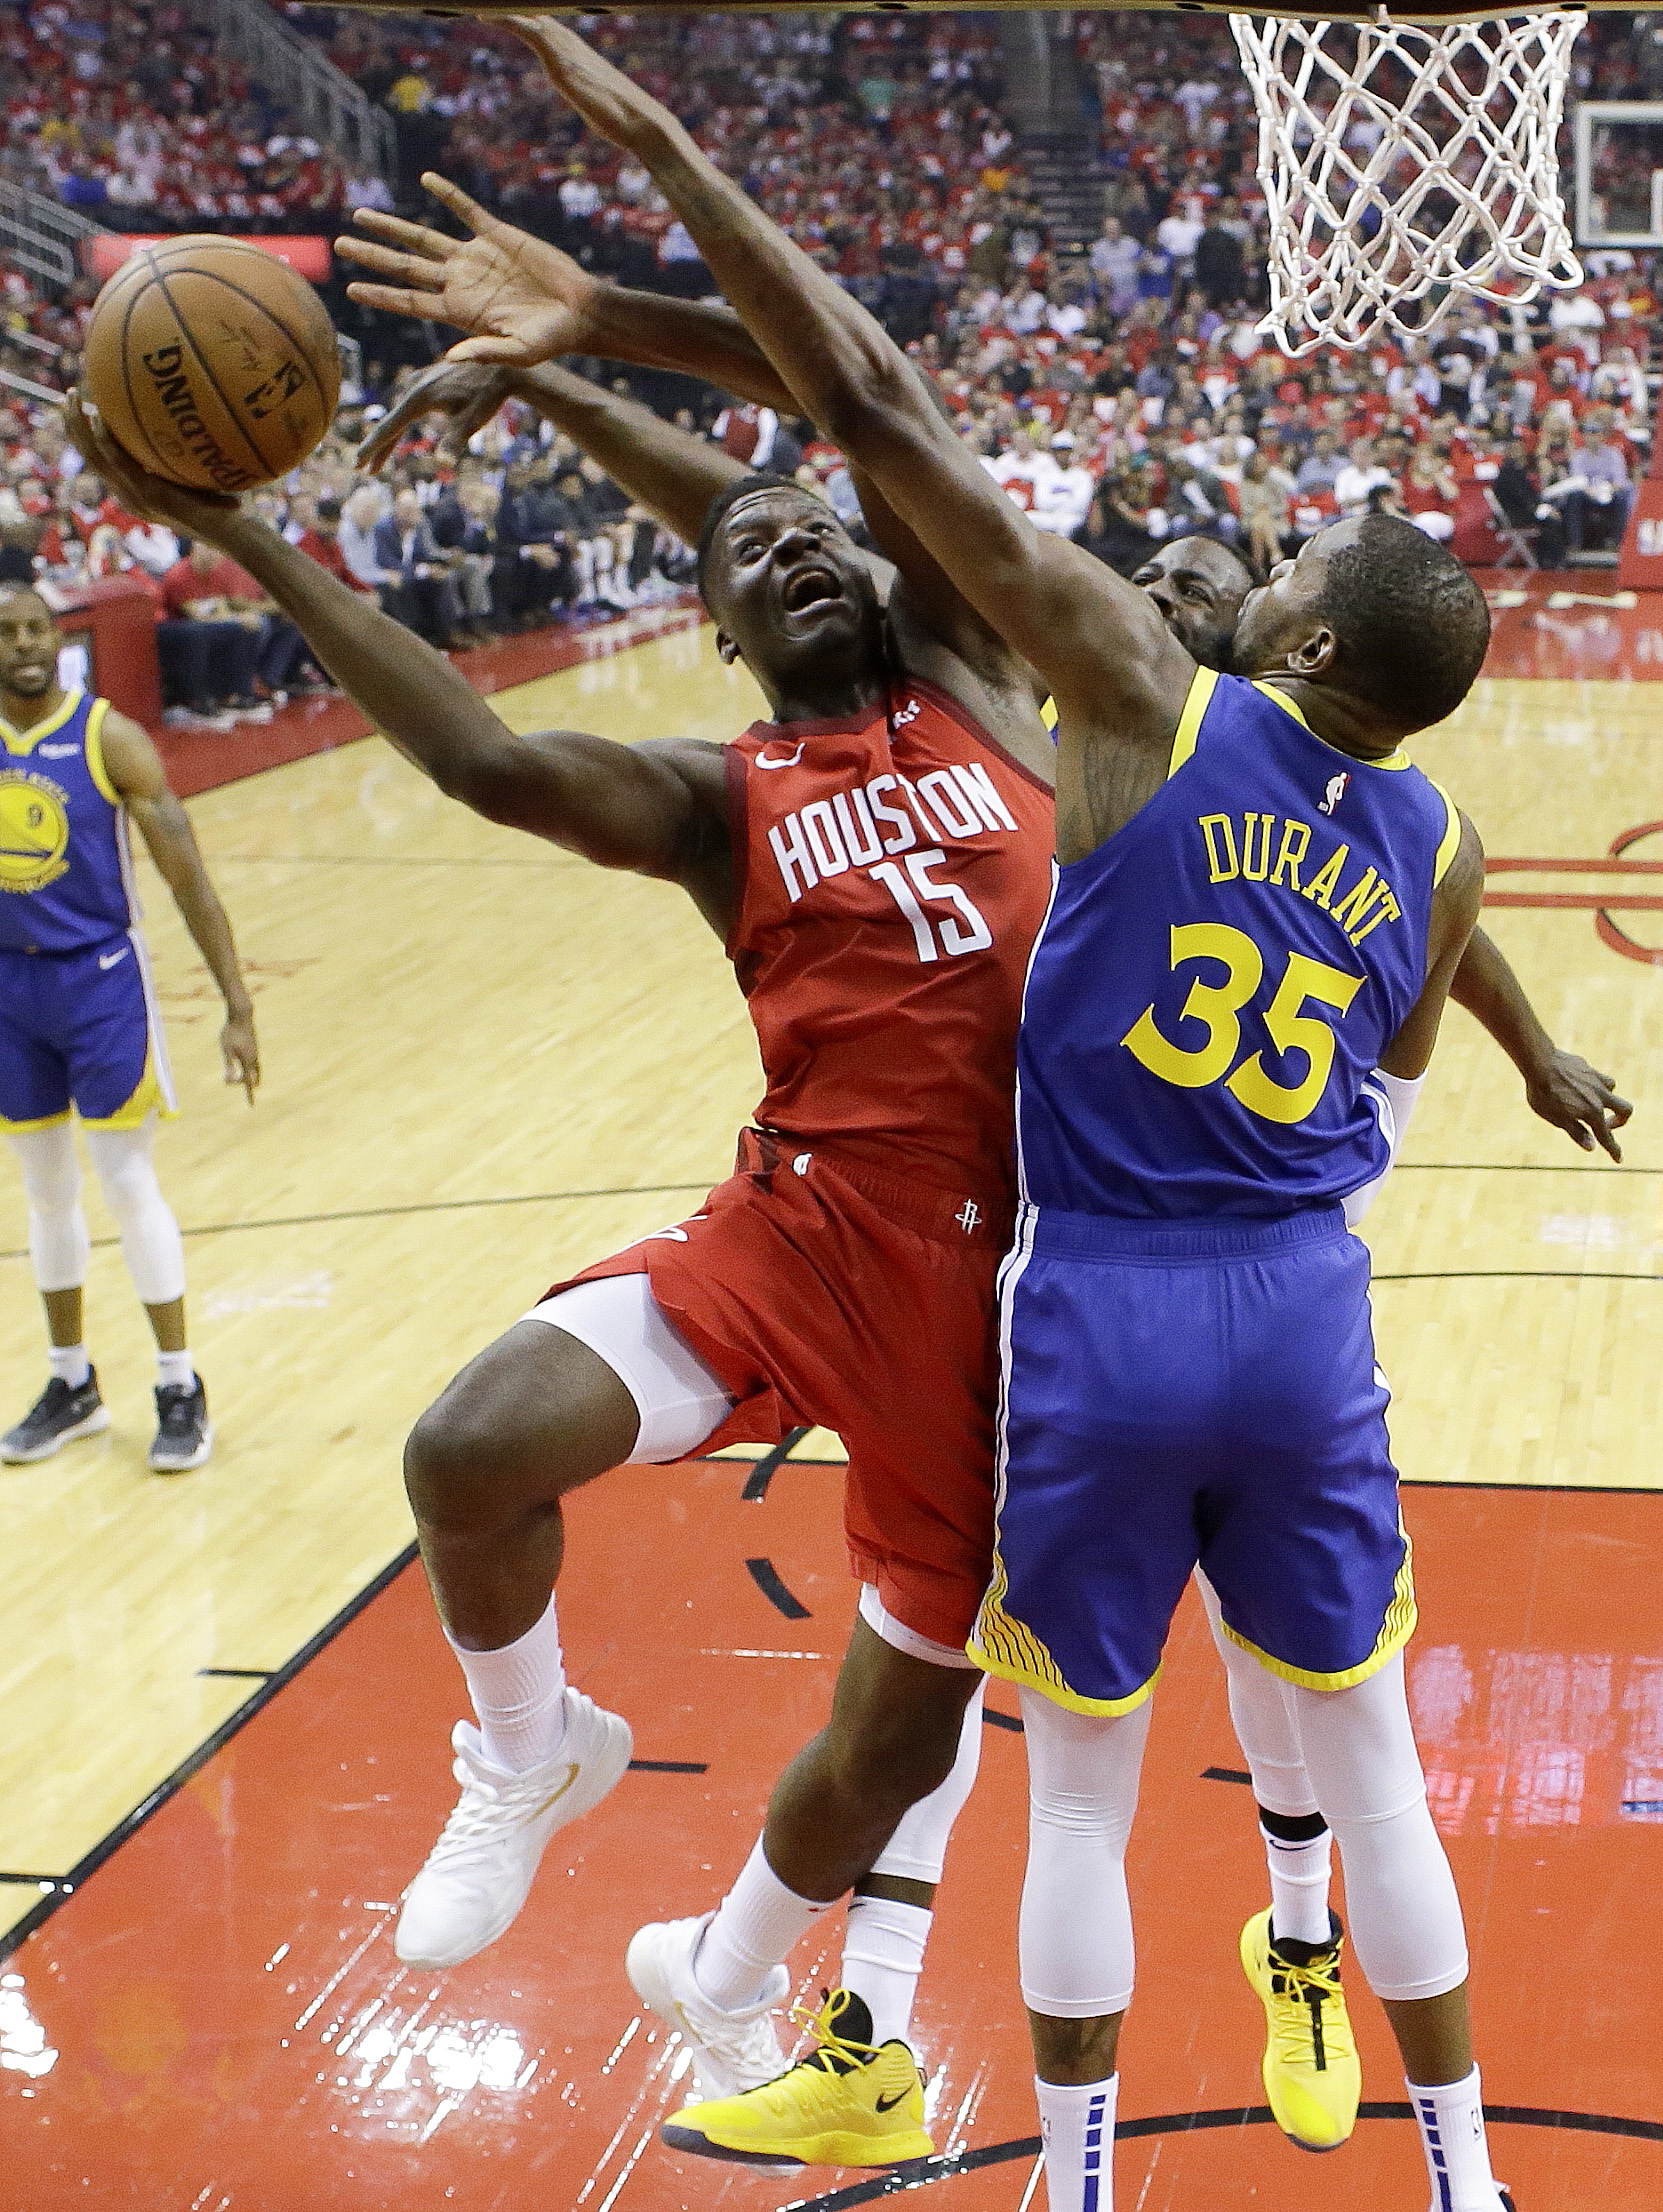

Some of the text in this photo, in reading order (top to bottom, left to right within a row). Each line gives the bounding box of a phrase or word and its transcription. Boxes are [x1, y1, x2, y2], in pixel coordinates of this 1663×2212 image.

[27, 803, 43, 828] 9
[768, 762, 1019, 903] HOUSTON
[1198, 812, 1402, 948] DURANT
[868, 848, 993, 963] 15
[1119, 921, 1368, 1124] 35
